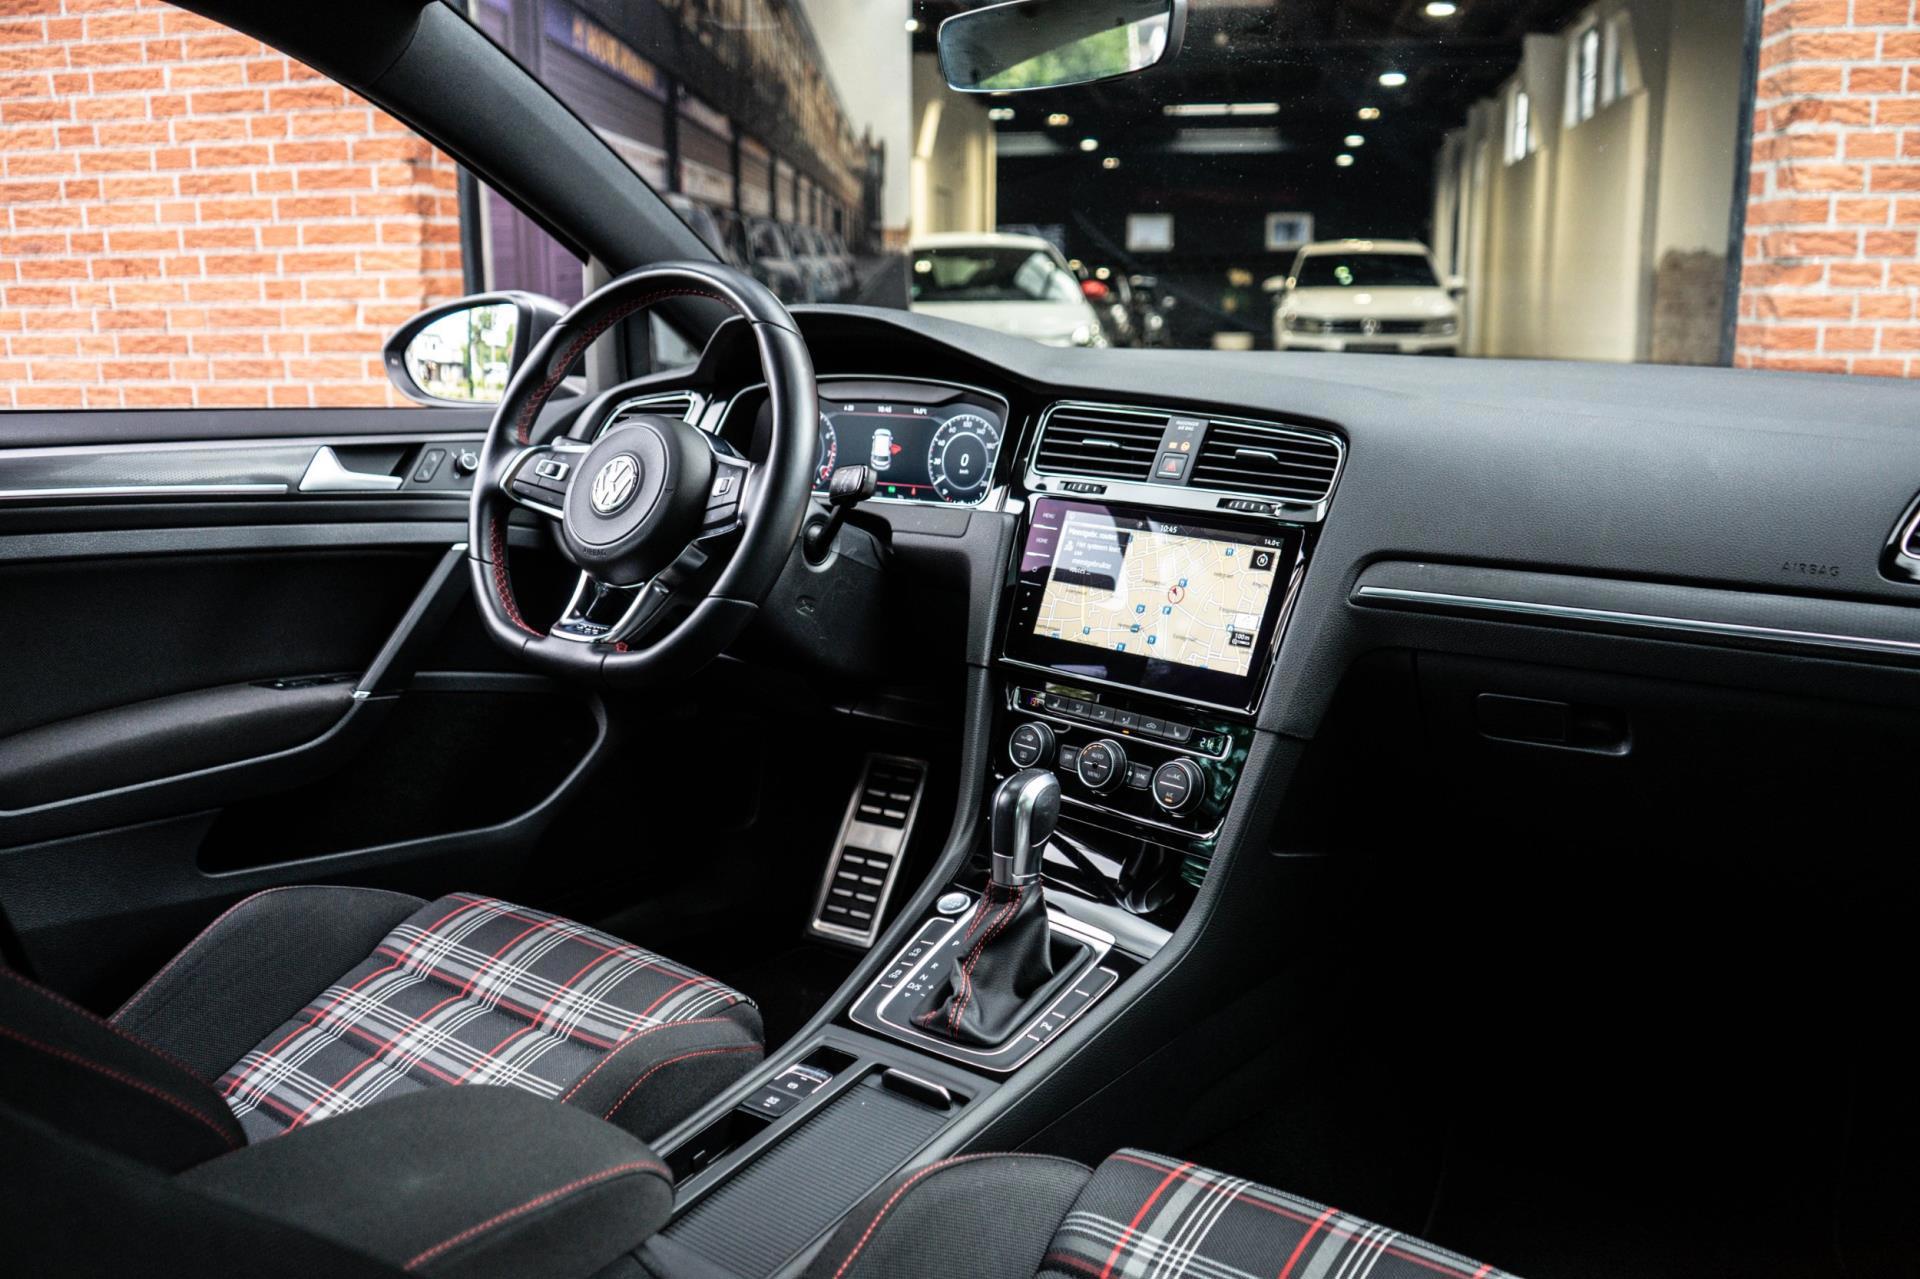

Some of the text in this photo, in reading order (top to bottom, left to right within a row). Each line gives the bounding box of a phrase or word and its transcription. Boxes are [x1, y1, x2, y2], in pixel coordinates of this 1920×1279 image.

[960, 453, 970, 467] 0
[1160, 524, 1178, 534] 10:45
[1782, 561, 1840, 577] AIRBAG
[907, 982, 922, 991] D/S
